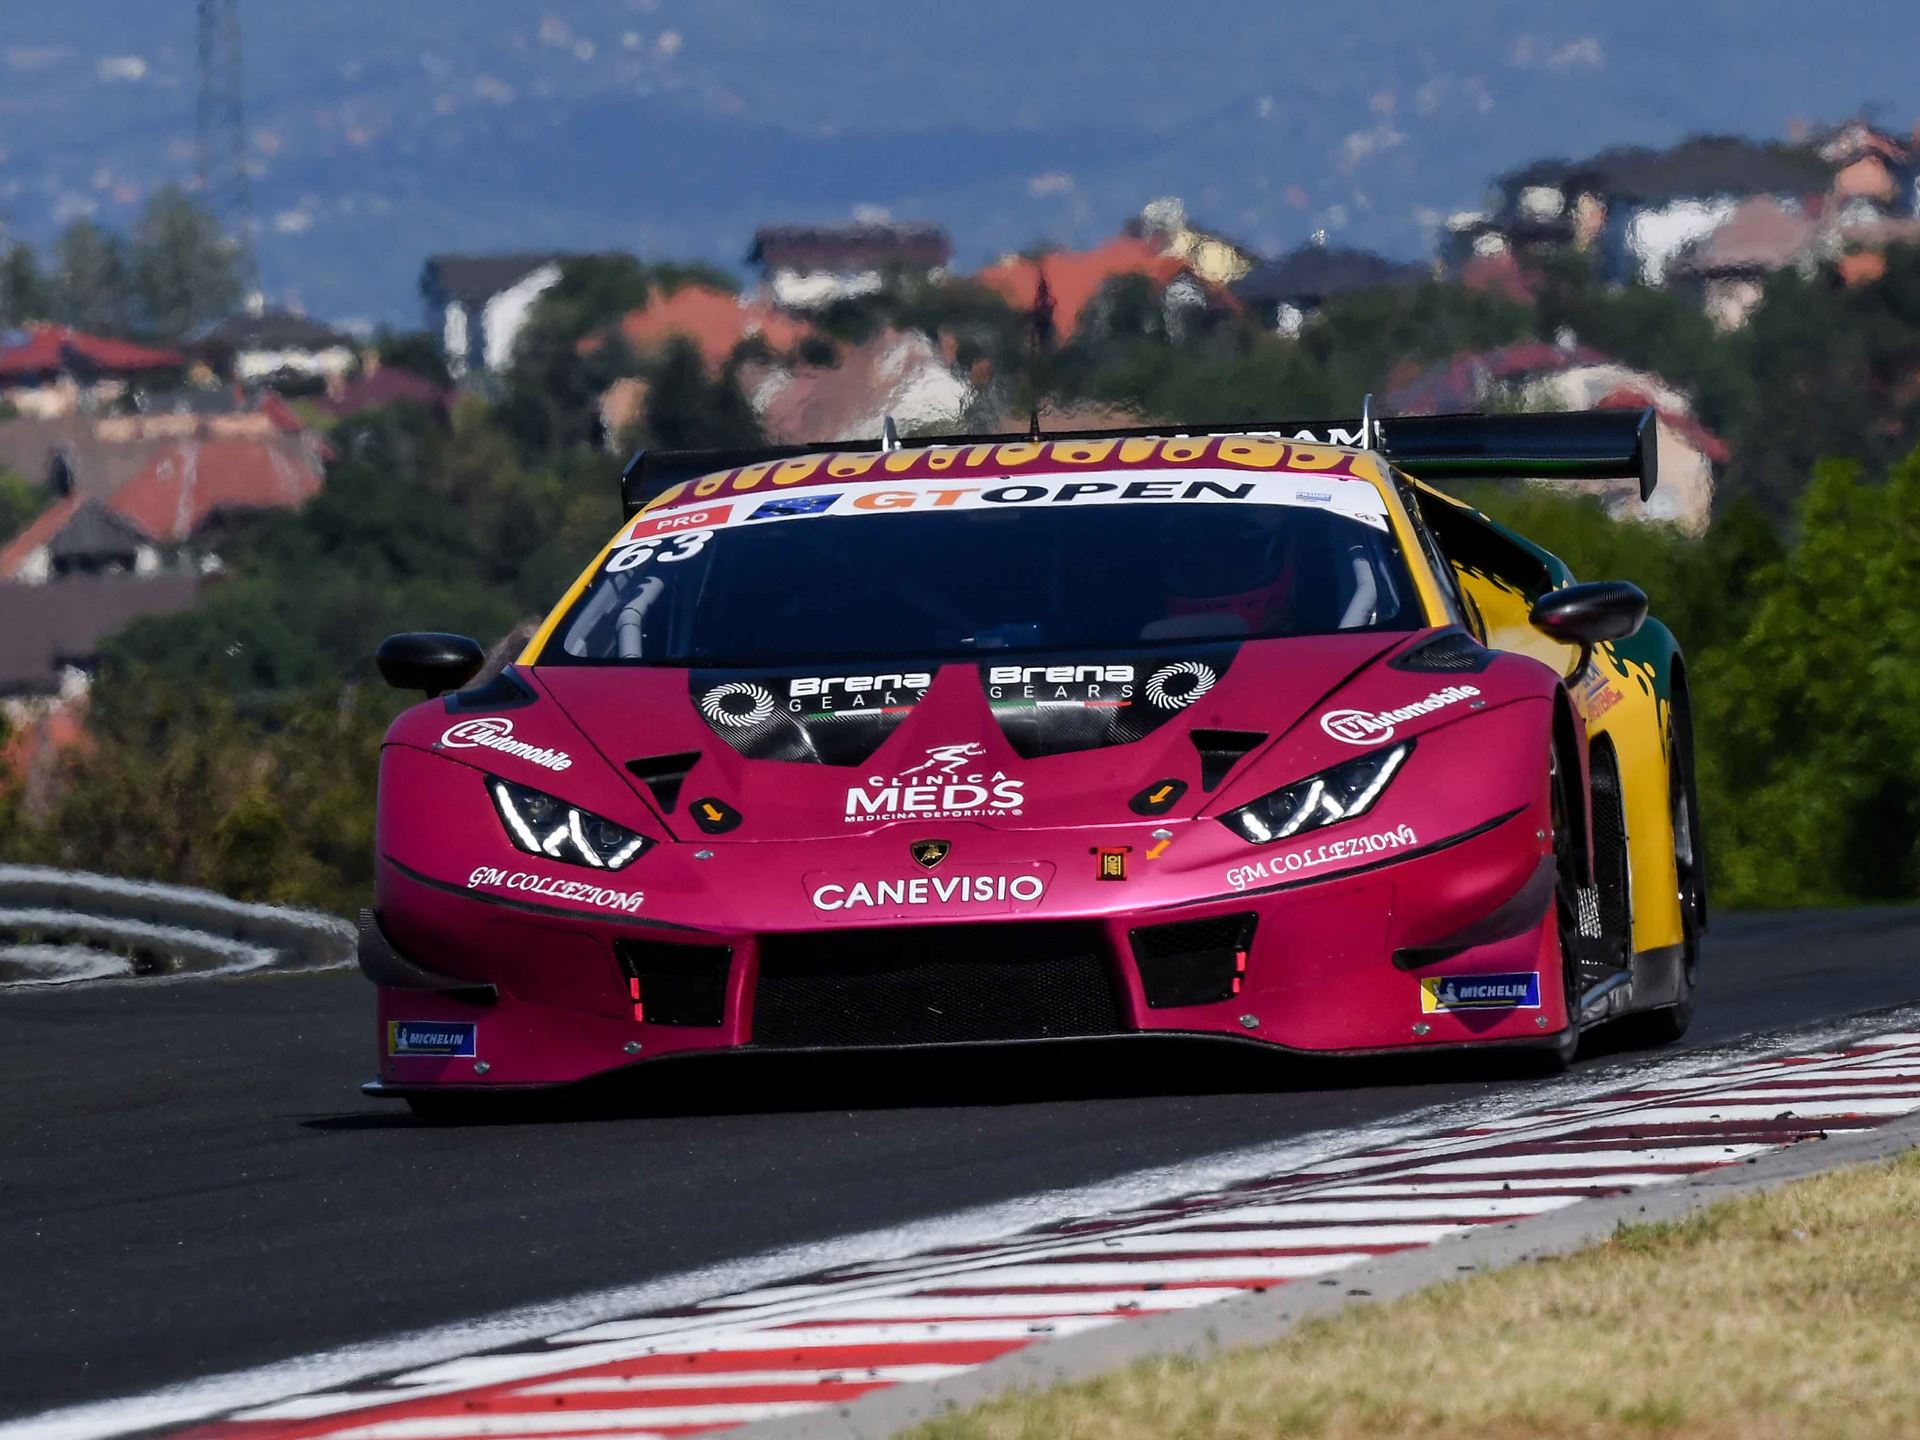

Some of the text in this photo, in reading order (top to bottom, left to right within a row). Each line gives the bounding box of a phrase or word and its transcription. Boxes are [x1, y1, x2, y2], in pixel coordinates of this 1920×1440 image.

[656, 512, 709, 531] PRO
[605, 530, 714, 572] 63
[990, 665, 1134, 684] Brena
[789, 673, 931, 698] Brena
[990, 684, 1134, 699] GEARS
[868, 771, 1007, 787] CLINICA
[845, 780, 1025, 815] MEDS
[845, 809, 1006, 823] MEDICINA DEPORTIVA
[1107, 855, 1118, 875] OMP
[1226, 823, 1418, 891] GM COLLEZIONI
[467, 866, 645, 912] GM COLLEZIONI
[812, 876, 1044, 910] CANEVISIO
[1460, 984, 1528, 998] MICHELIN
[409, 1033, 464, 1045] MICHELIN
